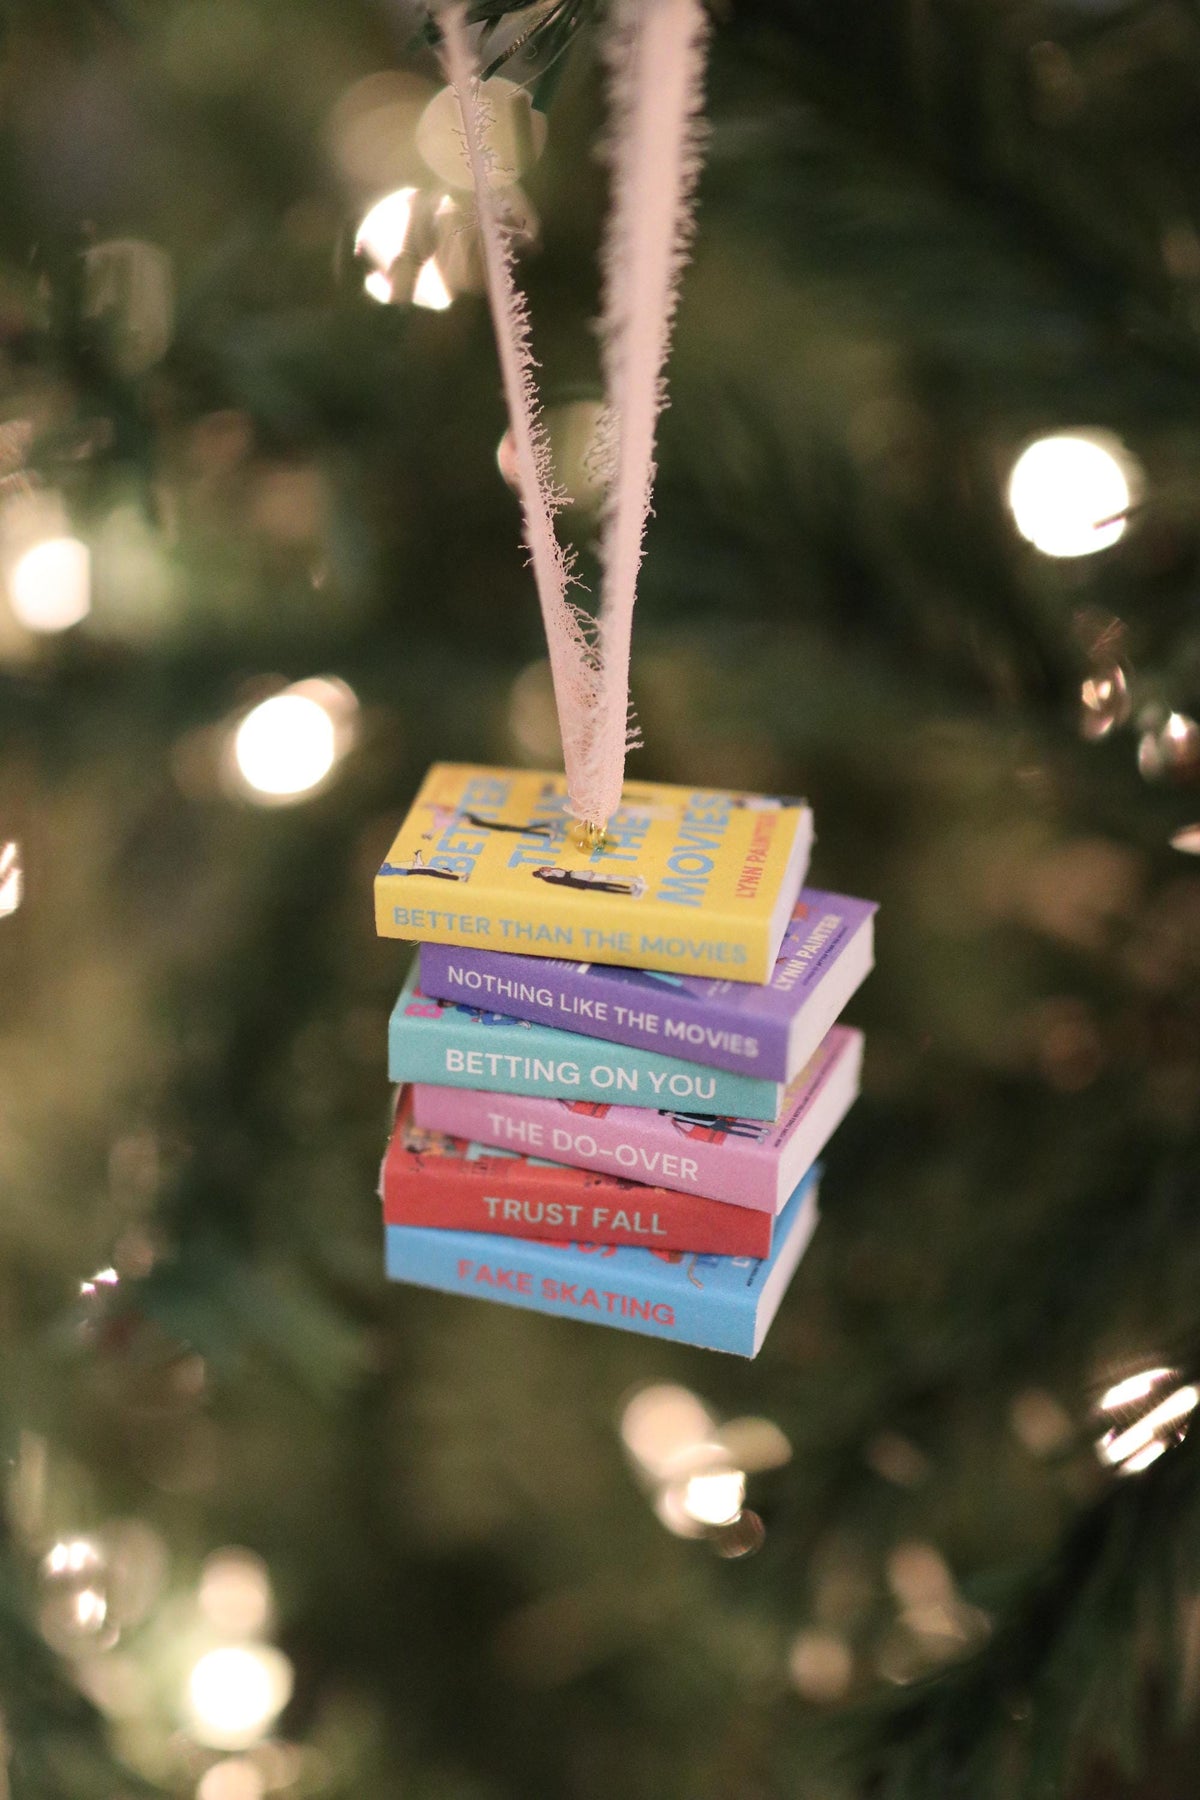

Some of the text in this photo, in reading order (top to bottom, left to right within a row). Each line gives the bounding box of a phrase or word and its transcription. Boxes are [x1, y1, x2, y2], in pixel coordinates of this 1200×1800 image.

[657, 794, 733, 907] MOVIES
[736, 865, 763, 898] LYNN
[393, 906, 747, 964] BETTER THAN THE MOVIES
[772, 959, 808, 992] LYNN
[447, 965, 553, 1008] NOTHING
[560, 993, 608, 1021] LIKE
[613, 1006, 660, 1034] THE
[664, 1019, 759, 1058] MOVIES
[446, 1048, 716, 1099] BETTING ON YOU
[487, 1112, 544, 1146] THE
[552, 1128, 699, 1181] DO-OVER
[483, 1196, 668, 1235] TRUST FALL
[457, 1259, 676, 1327] FAKE SKATING
